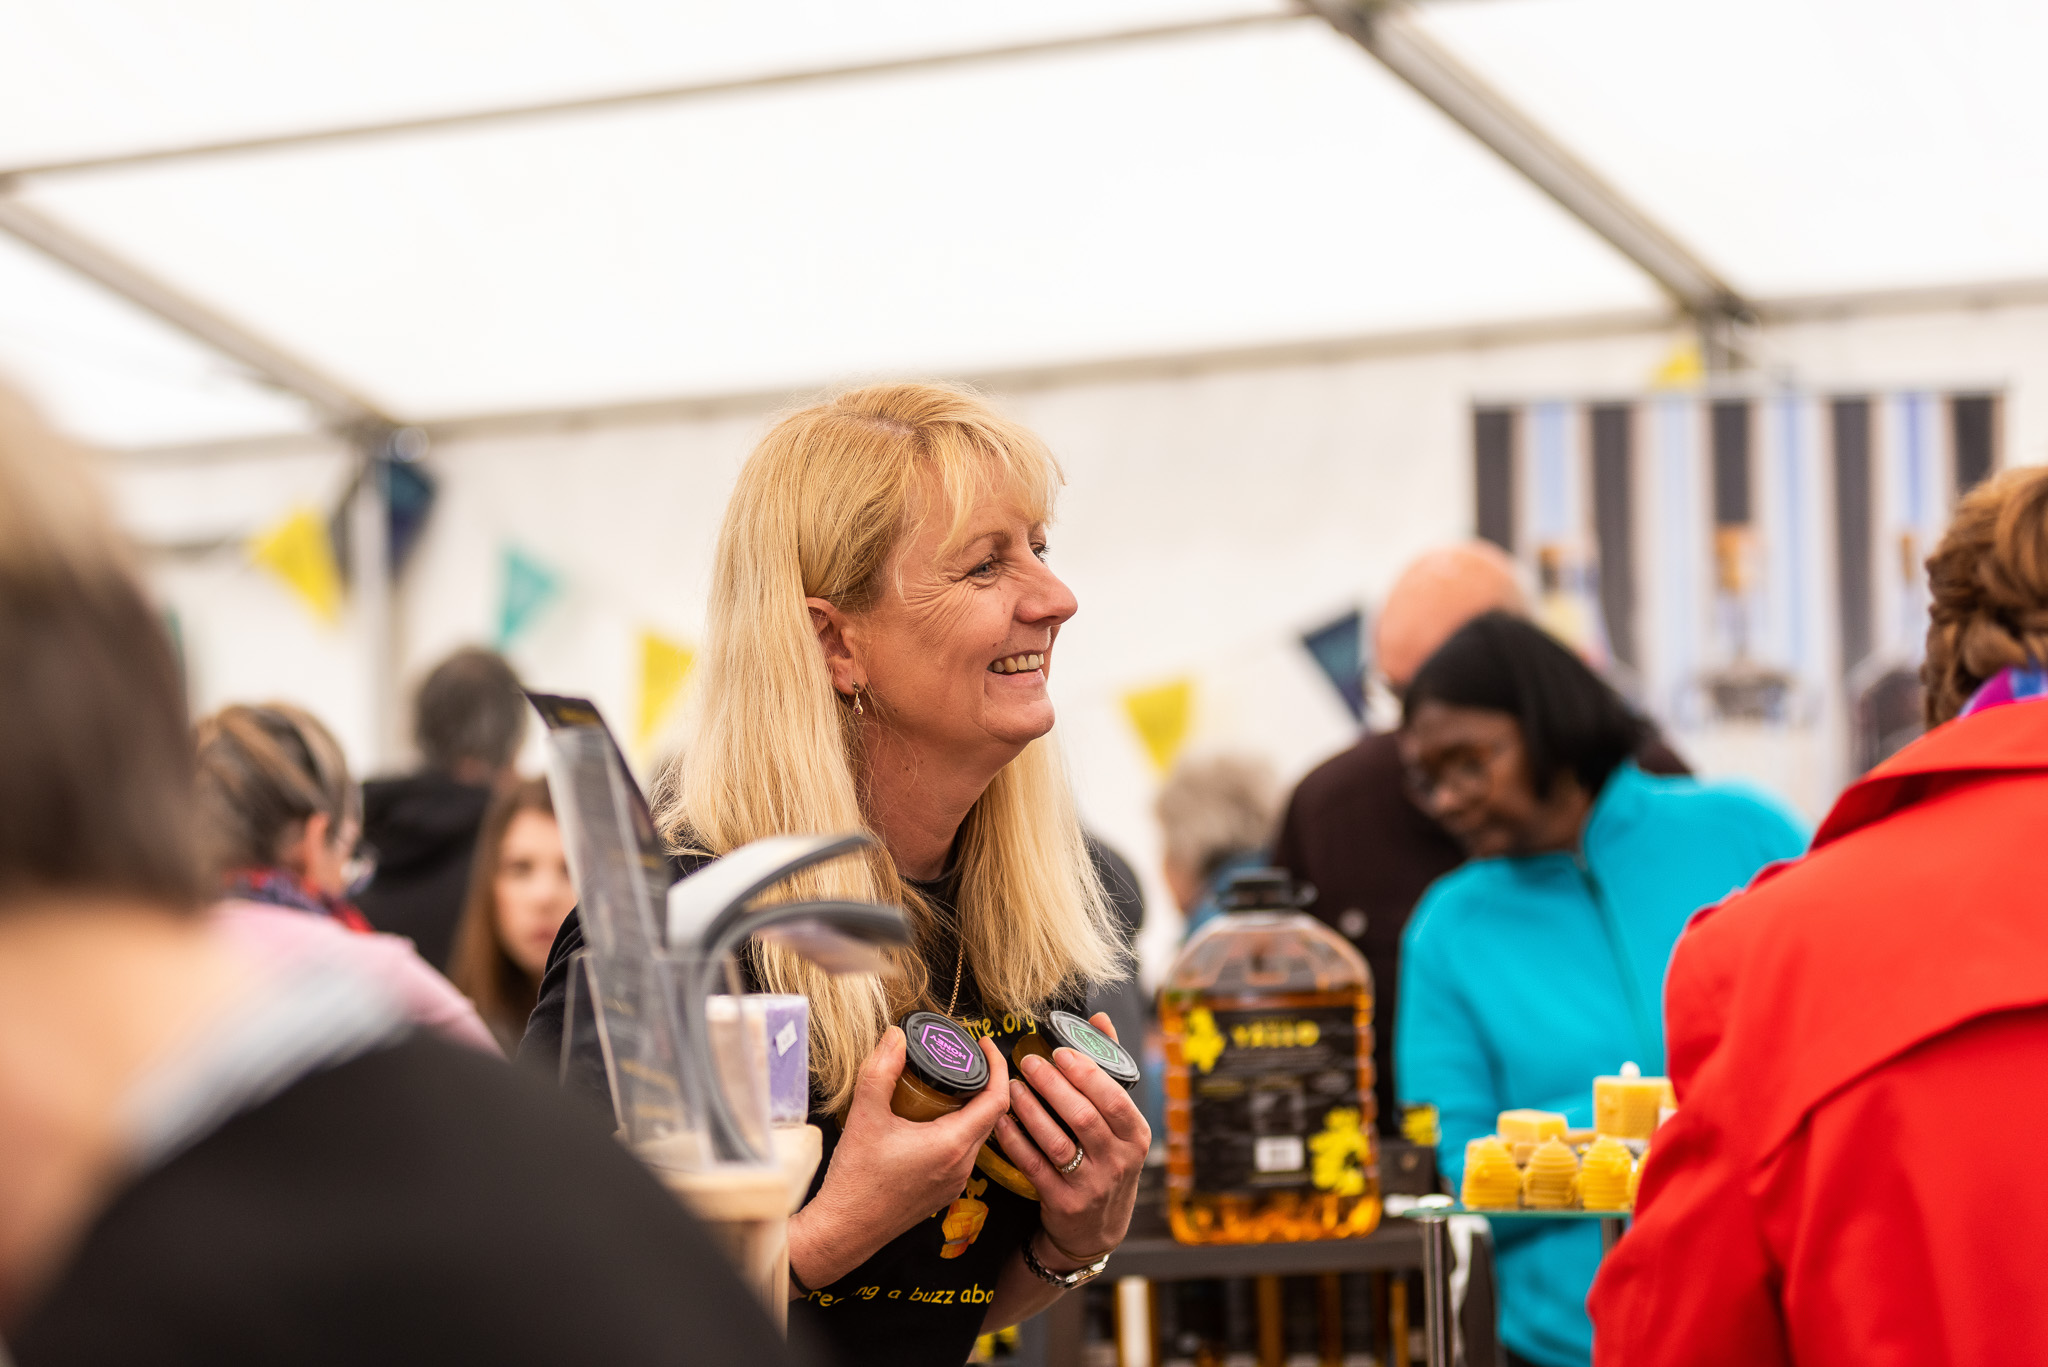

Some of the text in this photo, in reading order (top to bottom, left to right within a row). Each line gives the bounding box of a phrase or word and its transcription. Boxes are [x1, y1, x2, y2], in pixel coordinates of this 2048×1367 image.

[929, 1034, 967, 1061] HONEY
[887, 1289, 902, 1299] a
[908, 1287, 956, 1304] buzz
